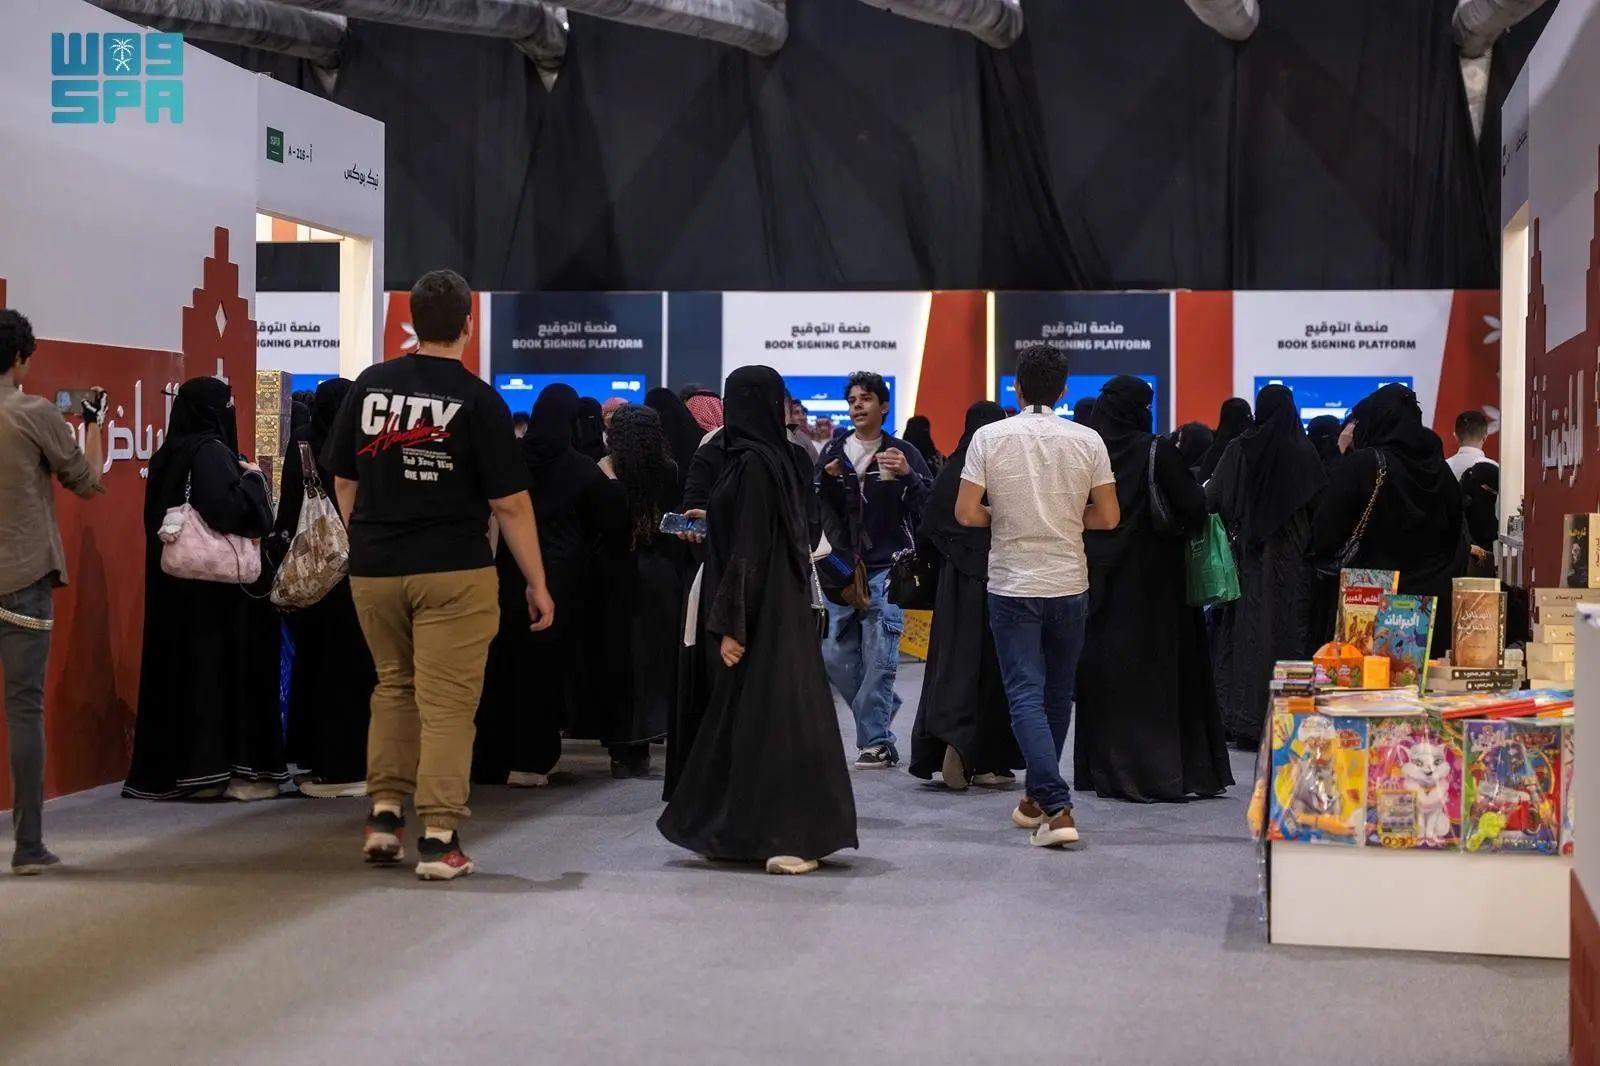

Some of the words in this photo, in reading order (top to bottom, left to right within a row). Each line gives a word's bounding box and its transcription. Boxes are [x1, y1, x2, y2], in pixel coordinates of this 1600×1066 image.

[344, 163, 366, 187] بوكس
[257, 321, 287, 335] التوق
[290, 321, 321, 333] منصة
[538, 321, 582, 337] التوقيع
[584, 321, 618, 334] منصة
[791, 322, 835, 338] التوقيع
[838, 322, 871, 334] منصة
[1042, 321, 1088, 337] التوقيع
[1089, 321, 1125, 334] منصة
[1305, 321, 1351, 337] التوقيع
[1354, 321, 1389, 334] منصة
[257, 339, 292, 348] IGNING
[512, 339, 542, 349] BOOK
[544, 339, 587, 349] SIGNING
[589, 339, 644, 349] PLATFORM
[765, 340, 794, 350] BOOK
[797, 340, 840, 350] SIGNING
[842, 340, 897, 350] PLATFORM
[1094, 340, 1152, 350] PLATFORM
[1277, 340, 1308, 350] BOOK
[1311, 340, 1356, 350] SIGNING
[1359, 340, 1416, 350] PLATFORM
[361, 392, 462, 442] CITY
[420, 471, 439, 481] WAY
